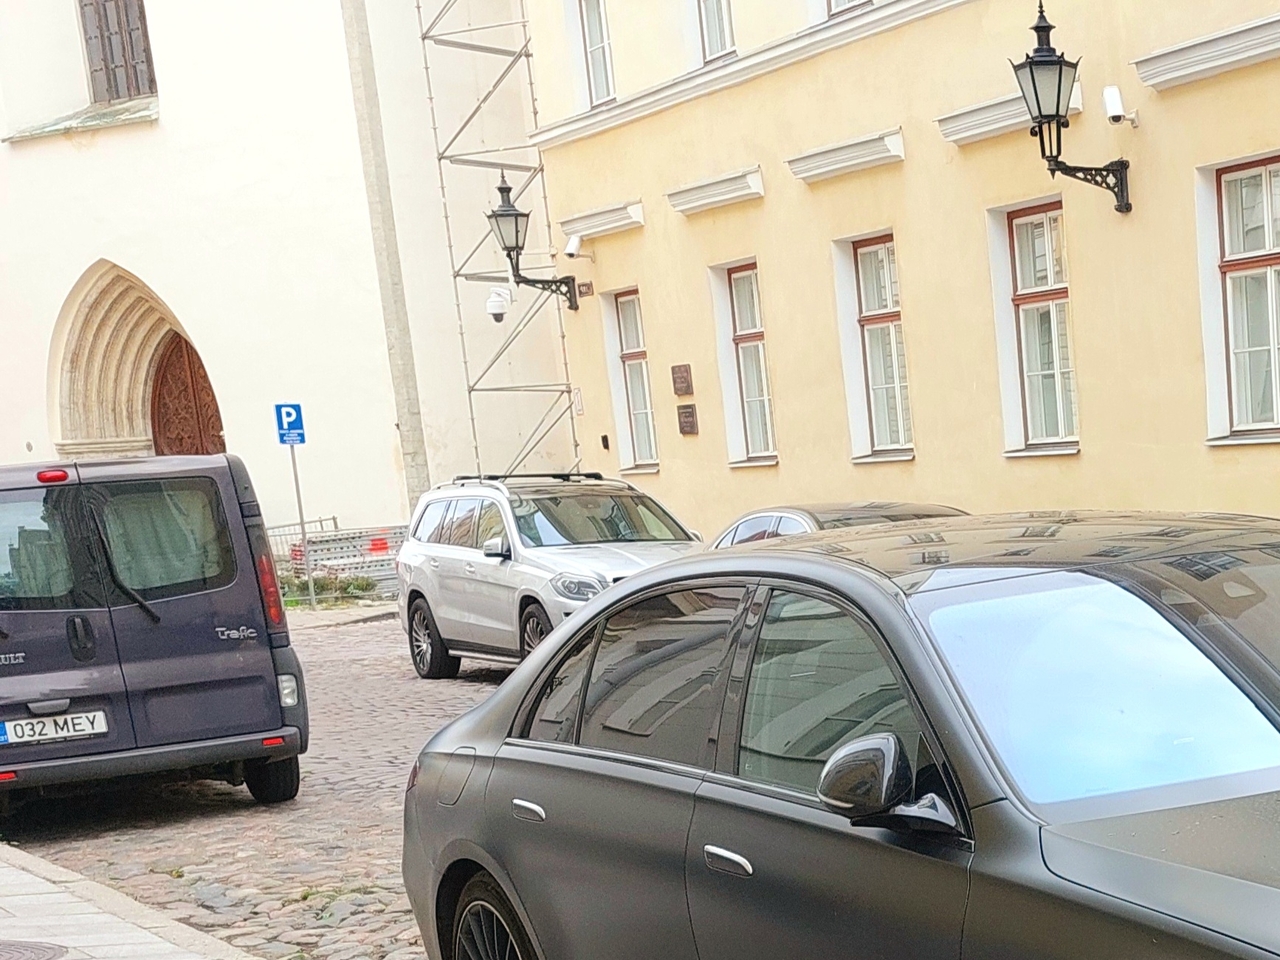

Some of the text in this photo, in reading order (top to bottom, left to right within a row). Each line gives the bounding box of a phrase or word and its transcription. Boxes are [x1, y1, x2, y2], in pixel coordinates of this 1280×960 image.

[281, 406, 297, 430] P
[215, 626, 258, 640] Trafic
[13, 714, 97, 739] 032 MEY
